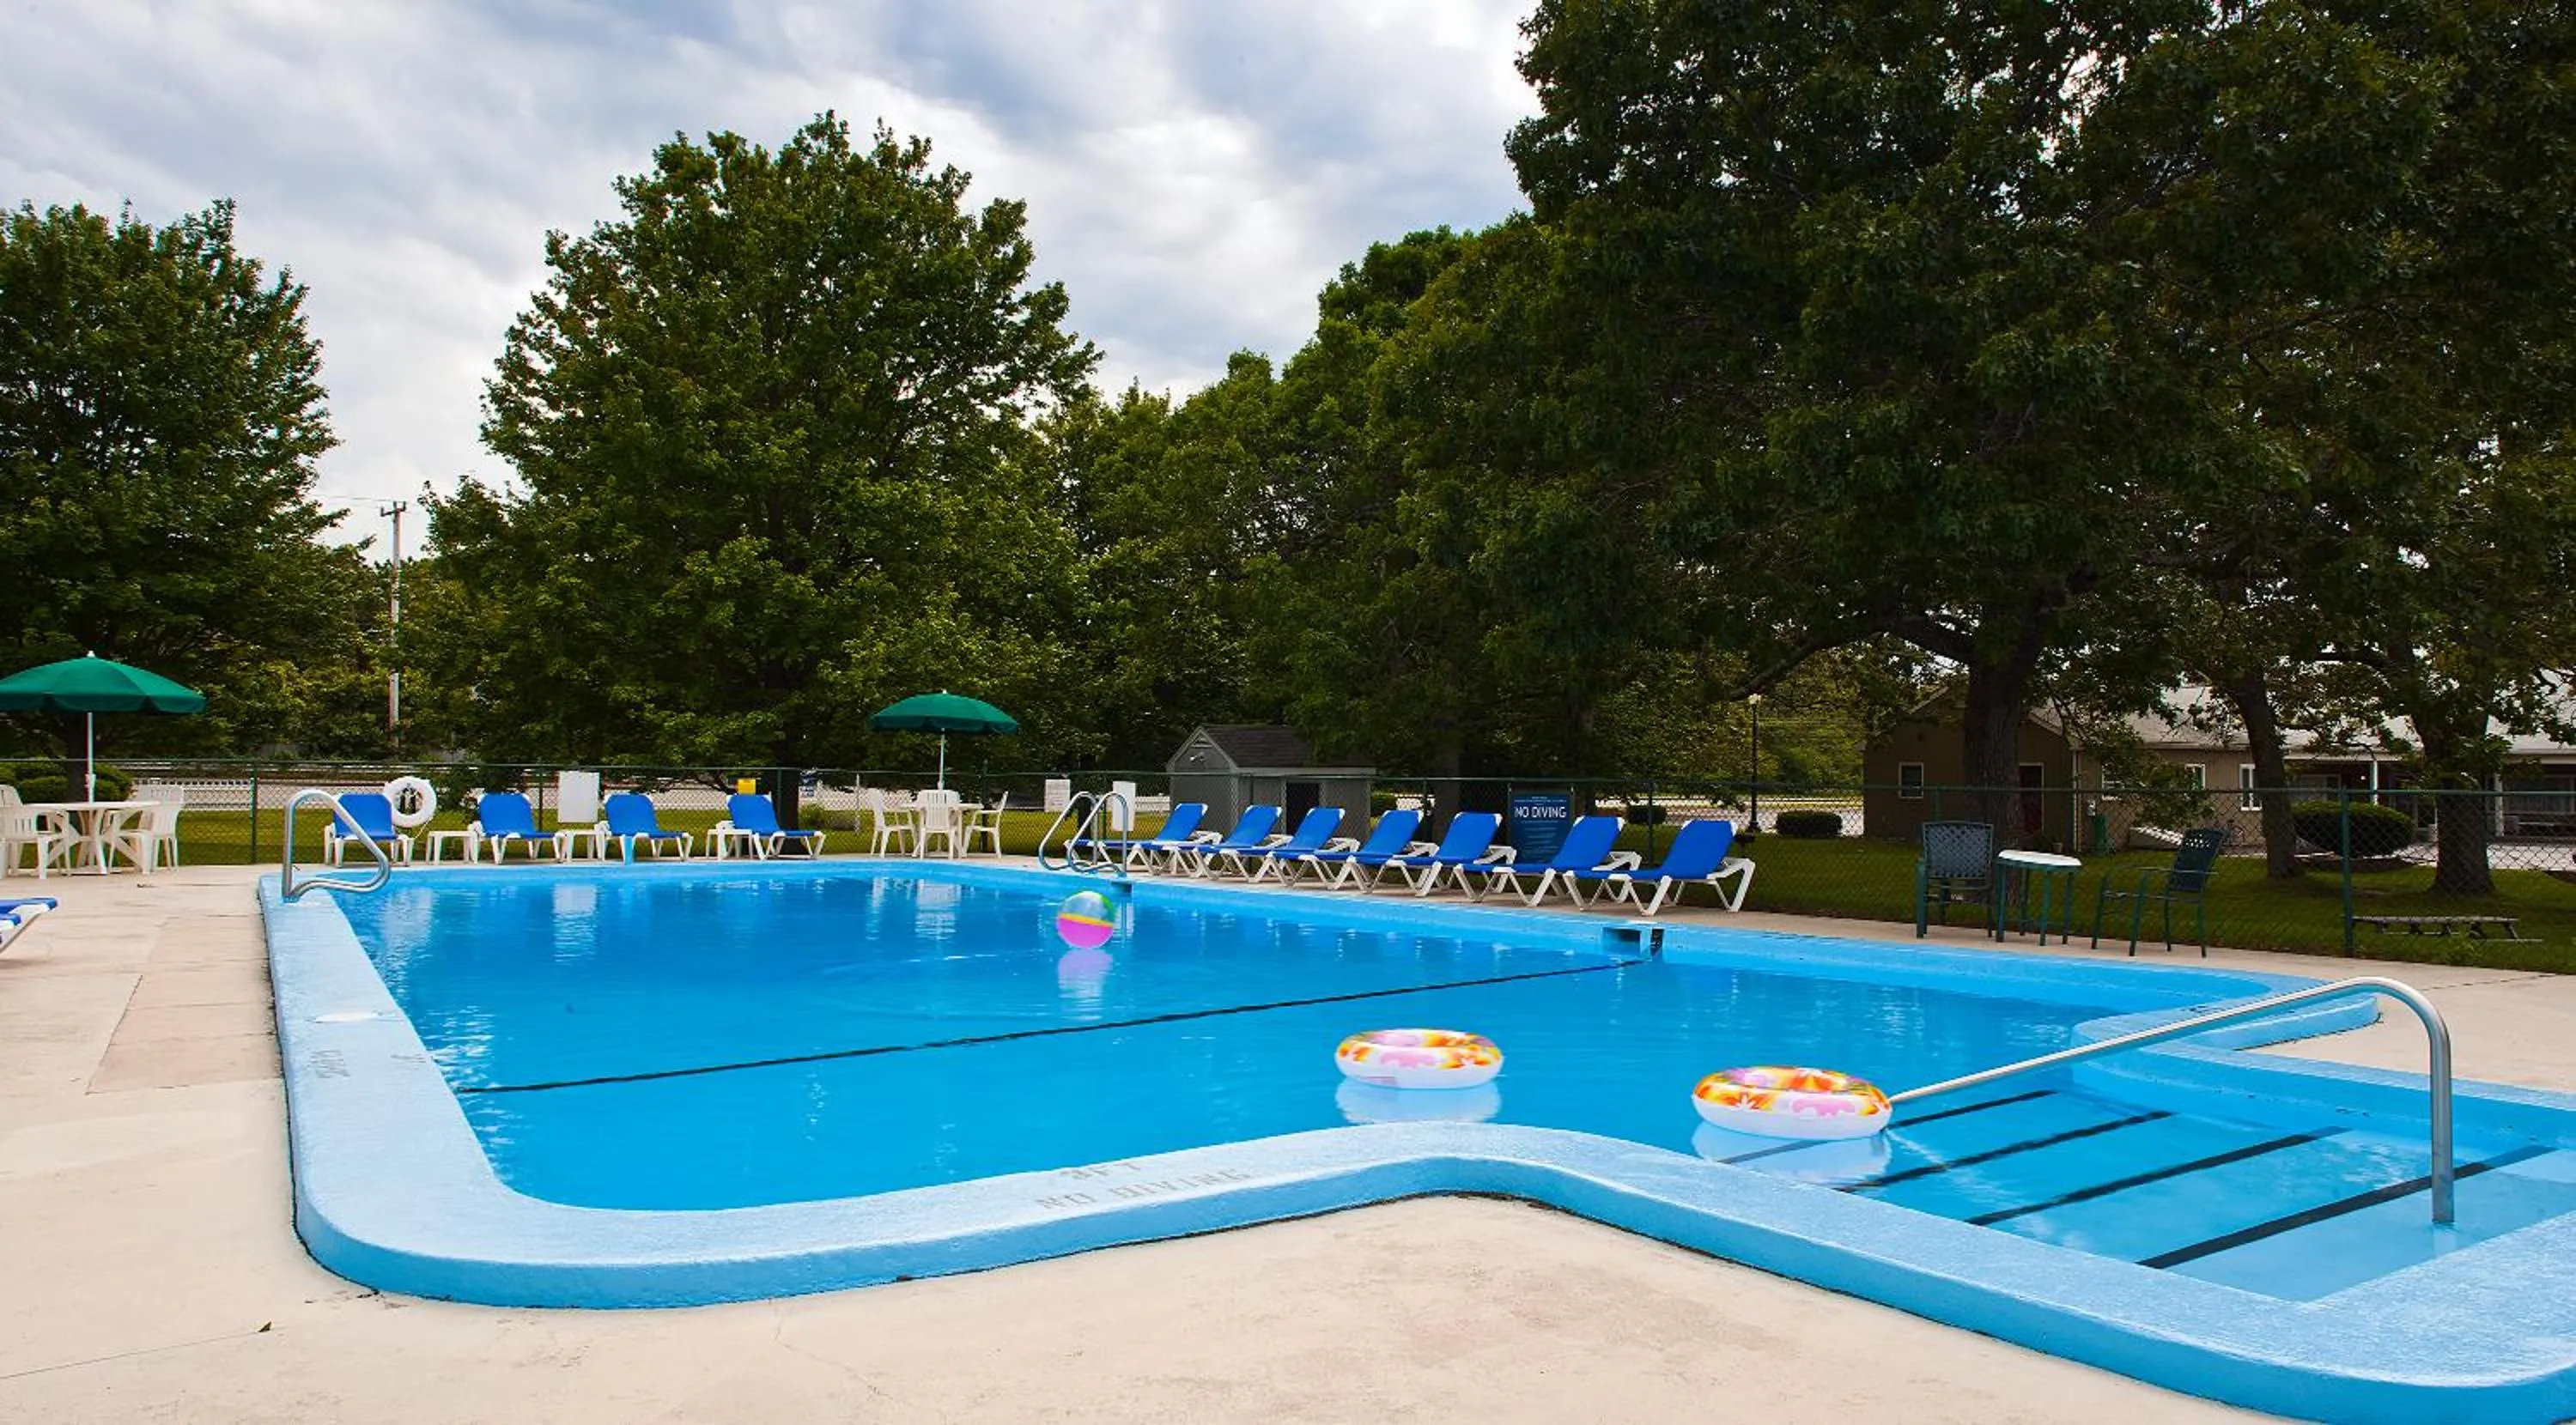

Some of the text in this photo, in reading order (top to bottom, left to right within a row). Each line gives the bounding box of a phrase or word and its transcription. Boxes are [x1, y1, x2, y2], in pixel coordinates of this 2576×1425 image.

[1514, 806, 1567, 818] NO DIVING
[1036, 1168, 1251, 1210] NO DIVING
